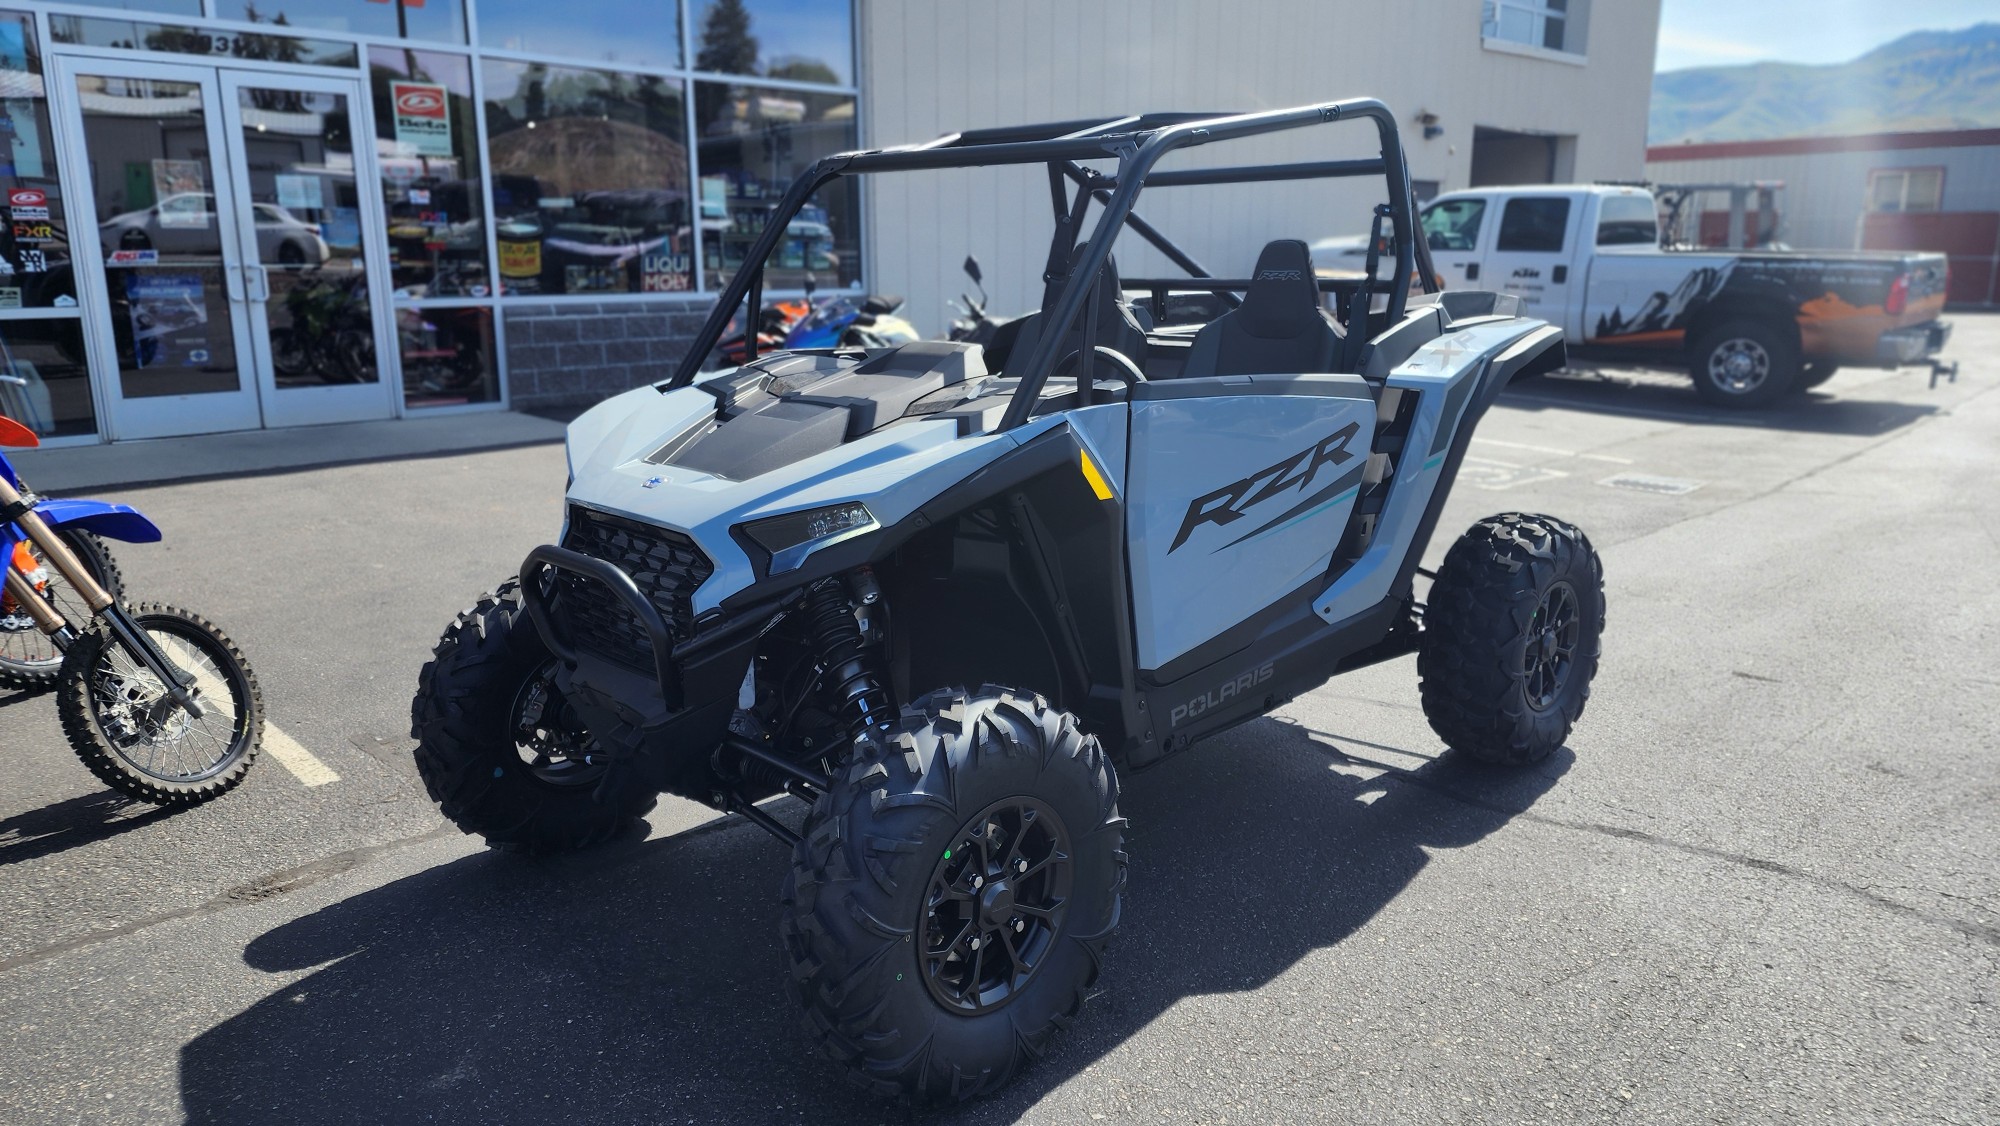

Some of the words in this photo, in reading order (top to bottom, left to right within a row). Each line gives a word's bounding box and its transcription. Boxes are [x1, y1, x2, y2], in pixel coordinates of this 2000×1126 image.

[399, 118, 447, 129] Beta
[13, 225, 52, 237] FXR
[645, 256, 689, 273] LIQUI
[645, 274, 688, 290] MOLY
[1257, 270, 1302, 281] RZR
[1166, 421, 1361, 556] RZR
[1170, 661, 1274, 728] POLARIS
